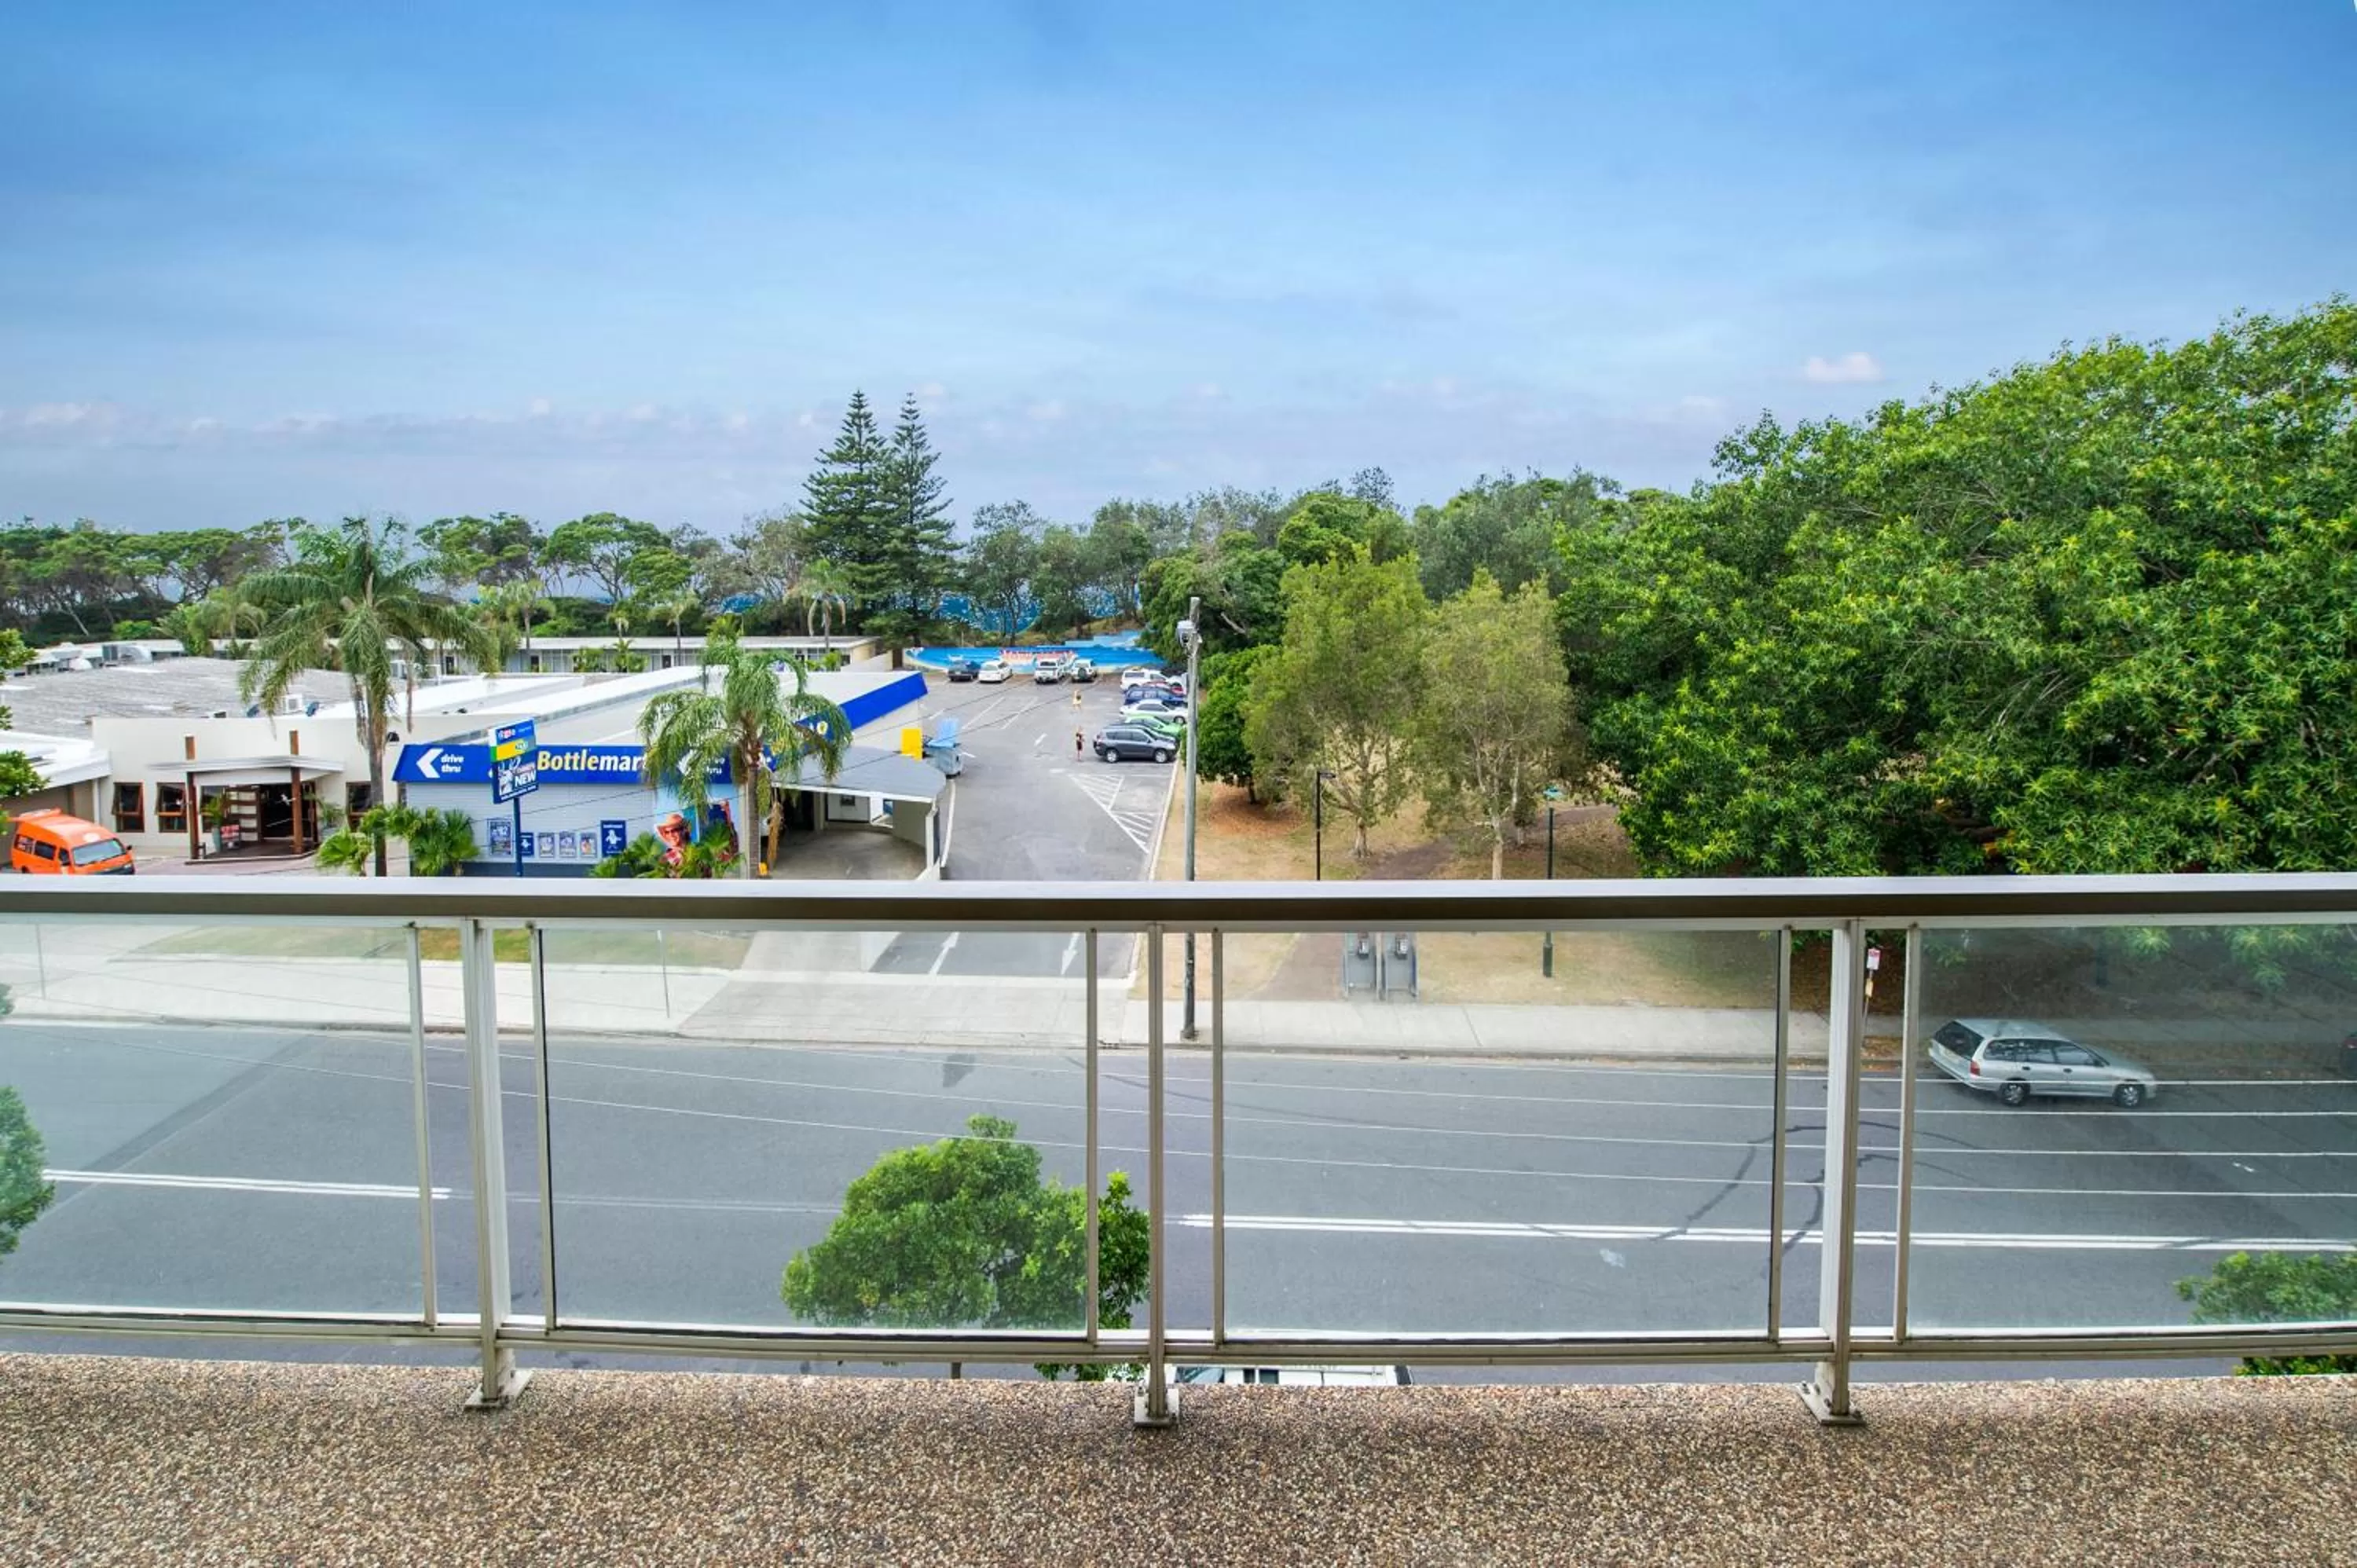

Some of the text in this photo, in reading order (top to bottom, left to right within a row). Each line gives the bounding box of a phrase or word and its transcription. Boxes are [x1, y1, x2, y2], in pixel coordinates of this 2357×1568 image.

[441, 754, 464, 763] drive
[441, 764, 461, 773] thru
[515, 769, 537, 787] NEW
